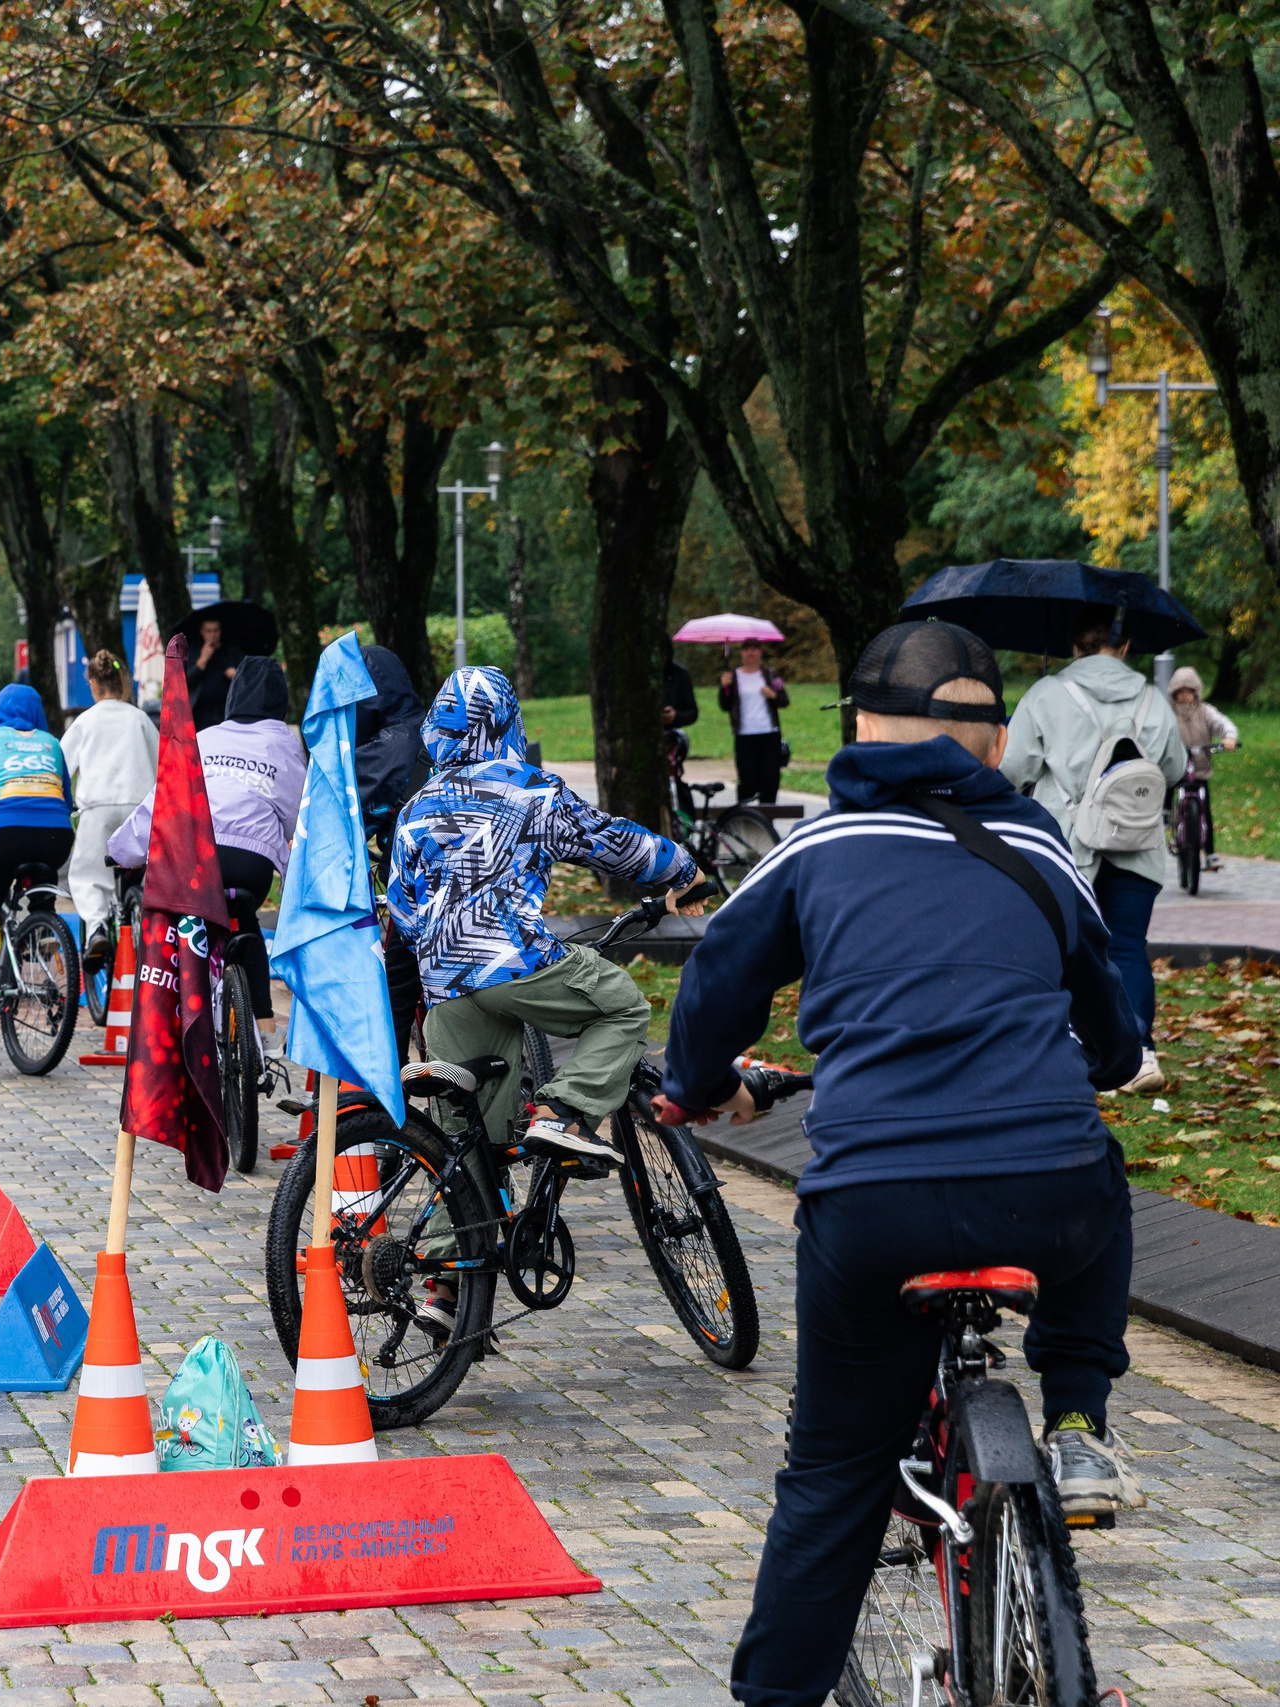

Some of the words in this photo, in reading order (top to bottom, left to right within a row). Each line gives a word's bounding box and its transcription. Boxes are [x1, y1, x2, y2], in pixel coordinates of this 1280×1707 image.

[3, 754, 58, 773] 665
[203, 754, 278, 781] OUTDOOR
[293, 1513, 455, 1543] ВЕЛОСИПЕДНЫЙ
[291, 1544, 344, 1562] КЛУБ
[348, 1537, 447, 1559] «МИНСК»
